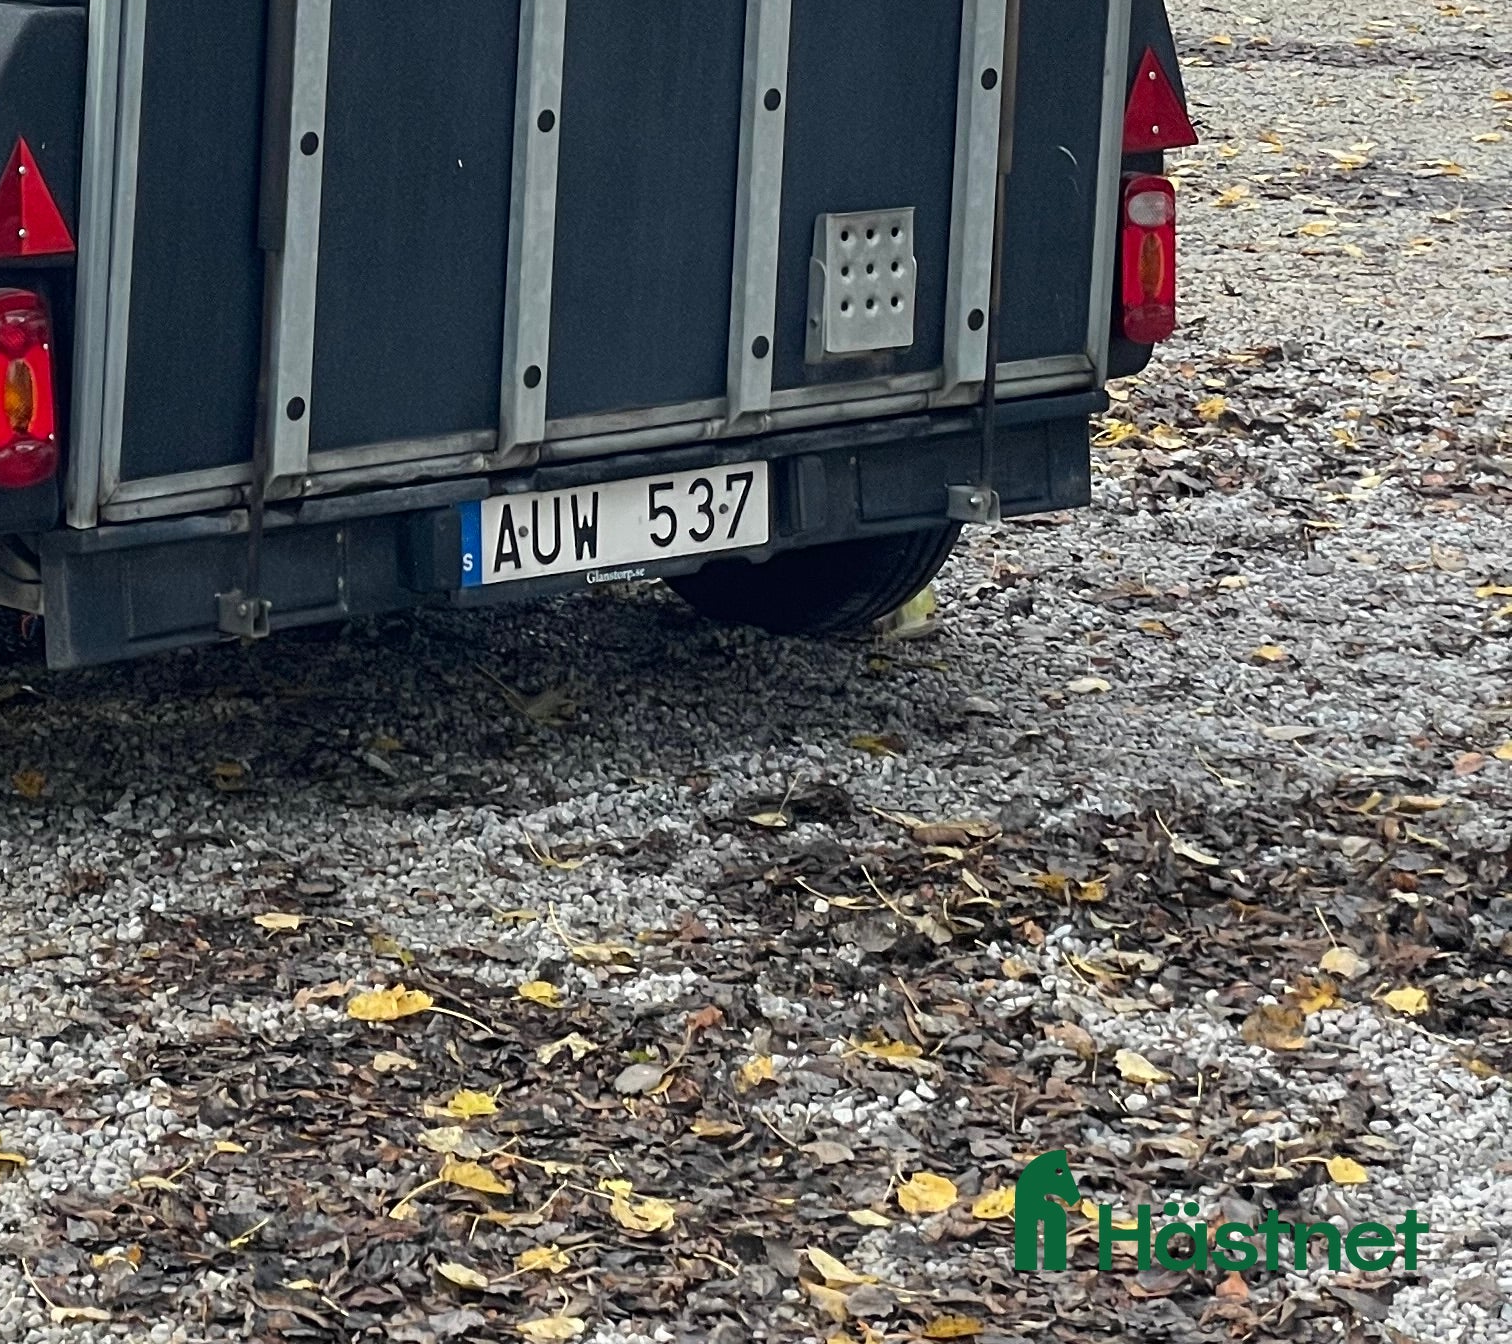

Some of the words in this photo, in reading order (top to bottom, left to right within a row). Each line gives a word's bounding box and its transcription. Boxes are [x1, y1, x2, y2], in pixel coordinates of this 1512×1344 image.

[462, 552, 474, 572] S
[493, 491, 599, 573] AUW
[648, 470, 754, 548] 537
[586, 567, 646, 585] Glanstorp.se
